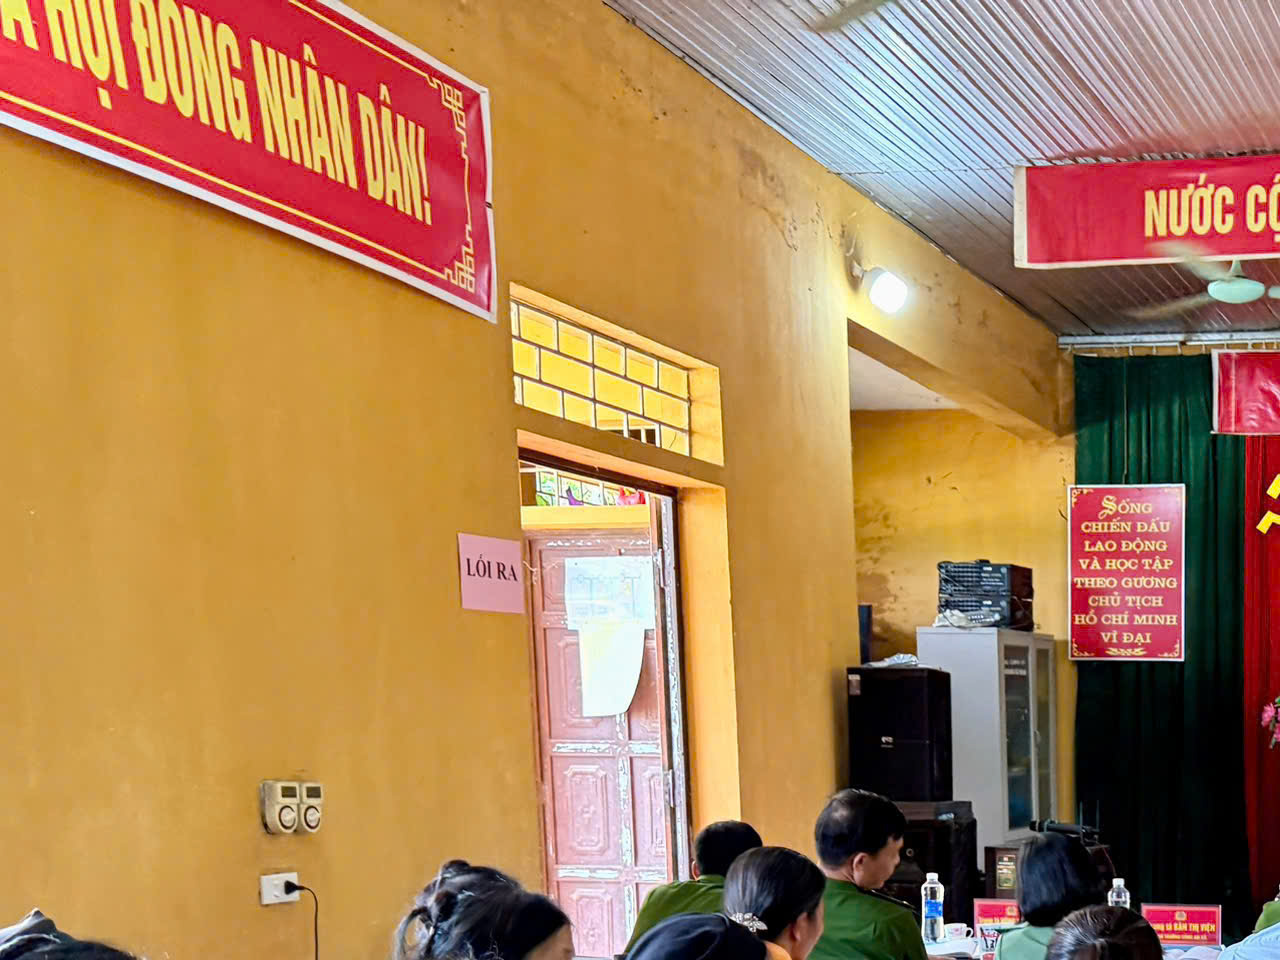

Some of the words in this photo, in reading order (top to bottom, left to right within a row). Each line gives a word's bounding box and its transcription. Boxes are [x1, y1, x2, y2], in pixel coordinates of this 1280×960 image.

[250, 38, 358, 191] NHÂN
[357, 82, 433, 226] DÂN!
[1145, 173, 1234, 236] NƯỚC
[1098, 495, 1153, 519] SỐNG
[1081, 517, 1132, 533] CHIẾN
[1136, 517, 1170, 532] ĐẤU
[1084, 541, 1117, 551] LAO
[1121, 537, 1168, 554] ĐỘNG
[466, 553, 493, 578] LỐI
[496, 561, 518, 582] RA
[1079, 557, 1102, 569] VÀ
[1105, 559, 1138, 572] HỌC
[1142, 556, 1173, 572] TẬP
[1074, 578, 1118, 588] THEO
[1122, 577, 1177, 588] GƯƠNG
[1088, 592, 1122, 607] CHỦ
[1125, 596, 1163, 609] TỊCH
[1074, 610, 1097, 625] HỒ
[1101, 611, 1129, 625] CHÍ
[1134, 614, 1177, 625] MINH
[1101, 633, 1118, 643] VĨ
[1122, 633, 1152, 645] ĐẠI
